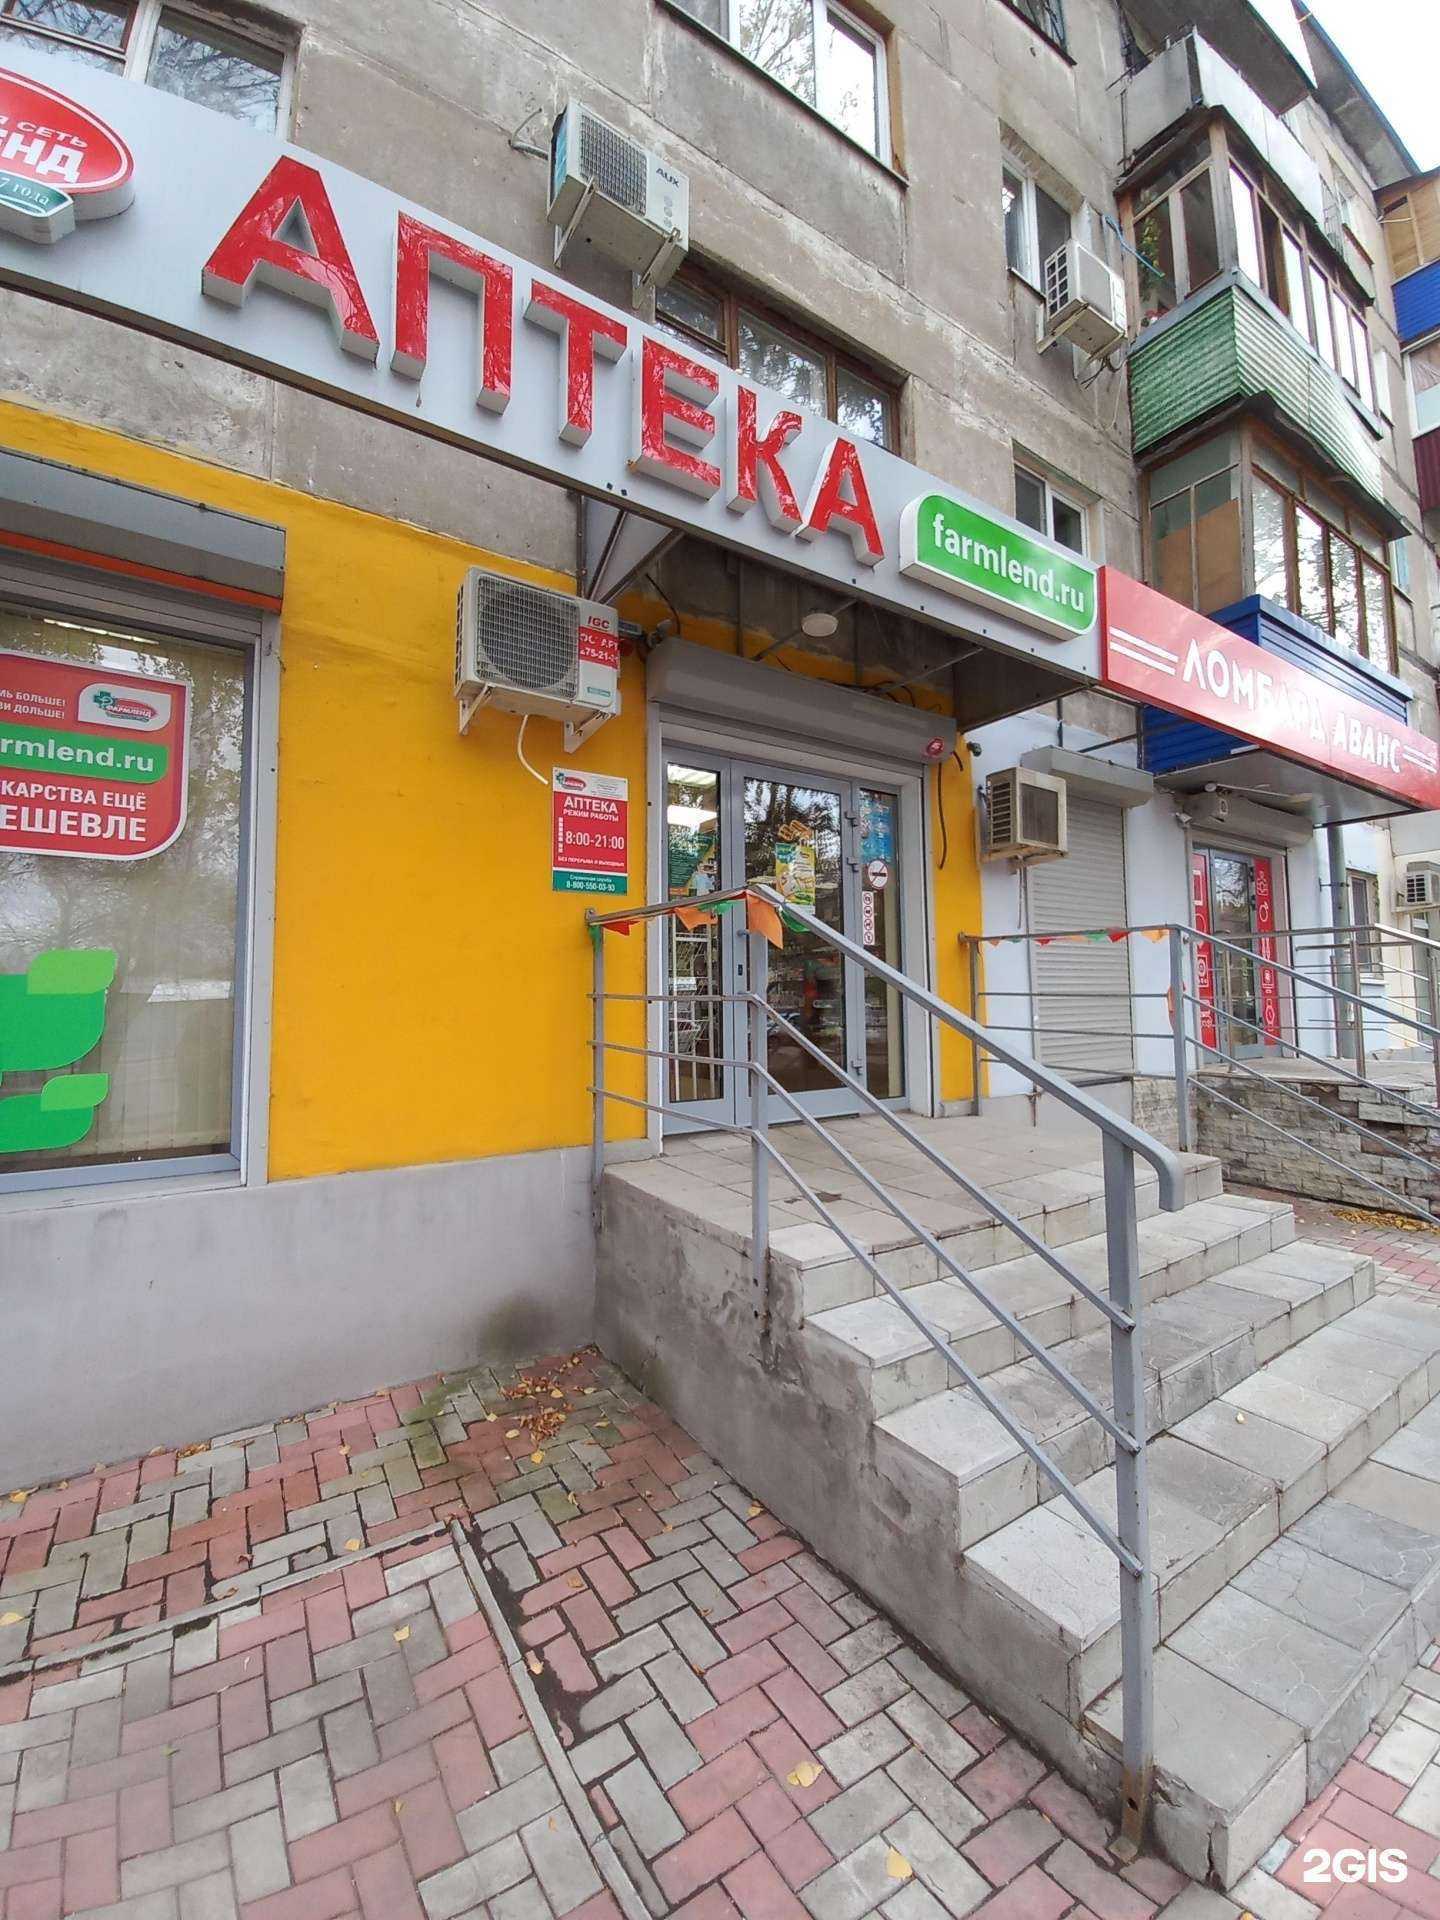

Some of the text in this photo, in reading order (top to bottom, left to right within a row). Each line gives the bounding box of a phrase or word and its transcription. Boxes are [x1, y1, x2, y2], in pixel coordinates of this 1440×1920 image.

[16, 121, 89, 148] СЕТЬ
[655, 167, 680, 189] AUX
[202, 155, 884, 566] АПТЕКА
[932, 512, 1085, 613] farmlend.ru
[16, 691, 66, 707] БОЛЬШЕ!
[13, 704, 65, 720] ДОЛЬШЕ!
[1332, 711, 1402, 775] АВАНС
[1, 780, 147, 811] КАРСТВА ЕЩЁ
[563, 796, 618, 814] АПТЕКА
[0, 804, 147, 842] ЕШЕВЛЕ
[563, 808, 619, 822] РЕЖИМ РАБОТЫ
[565, 830, 625, 850] 8:00-21:00
